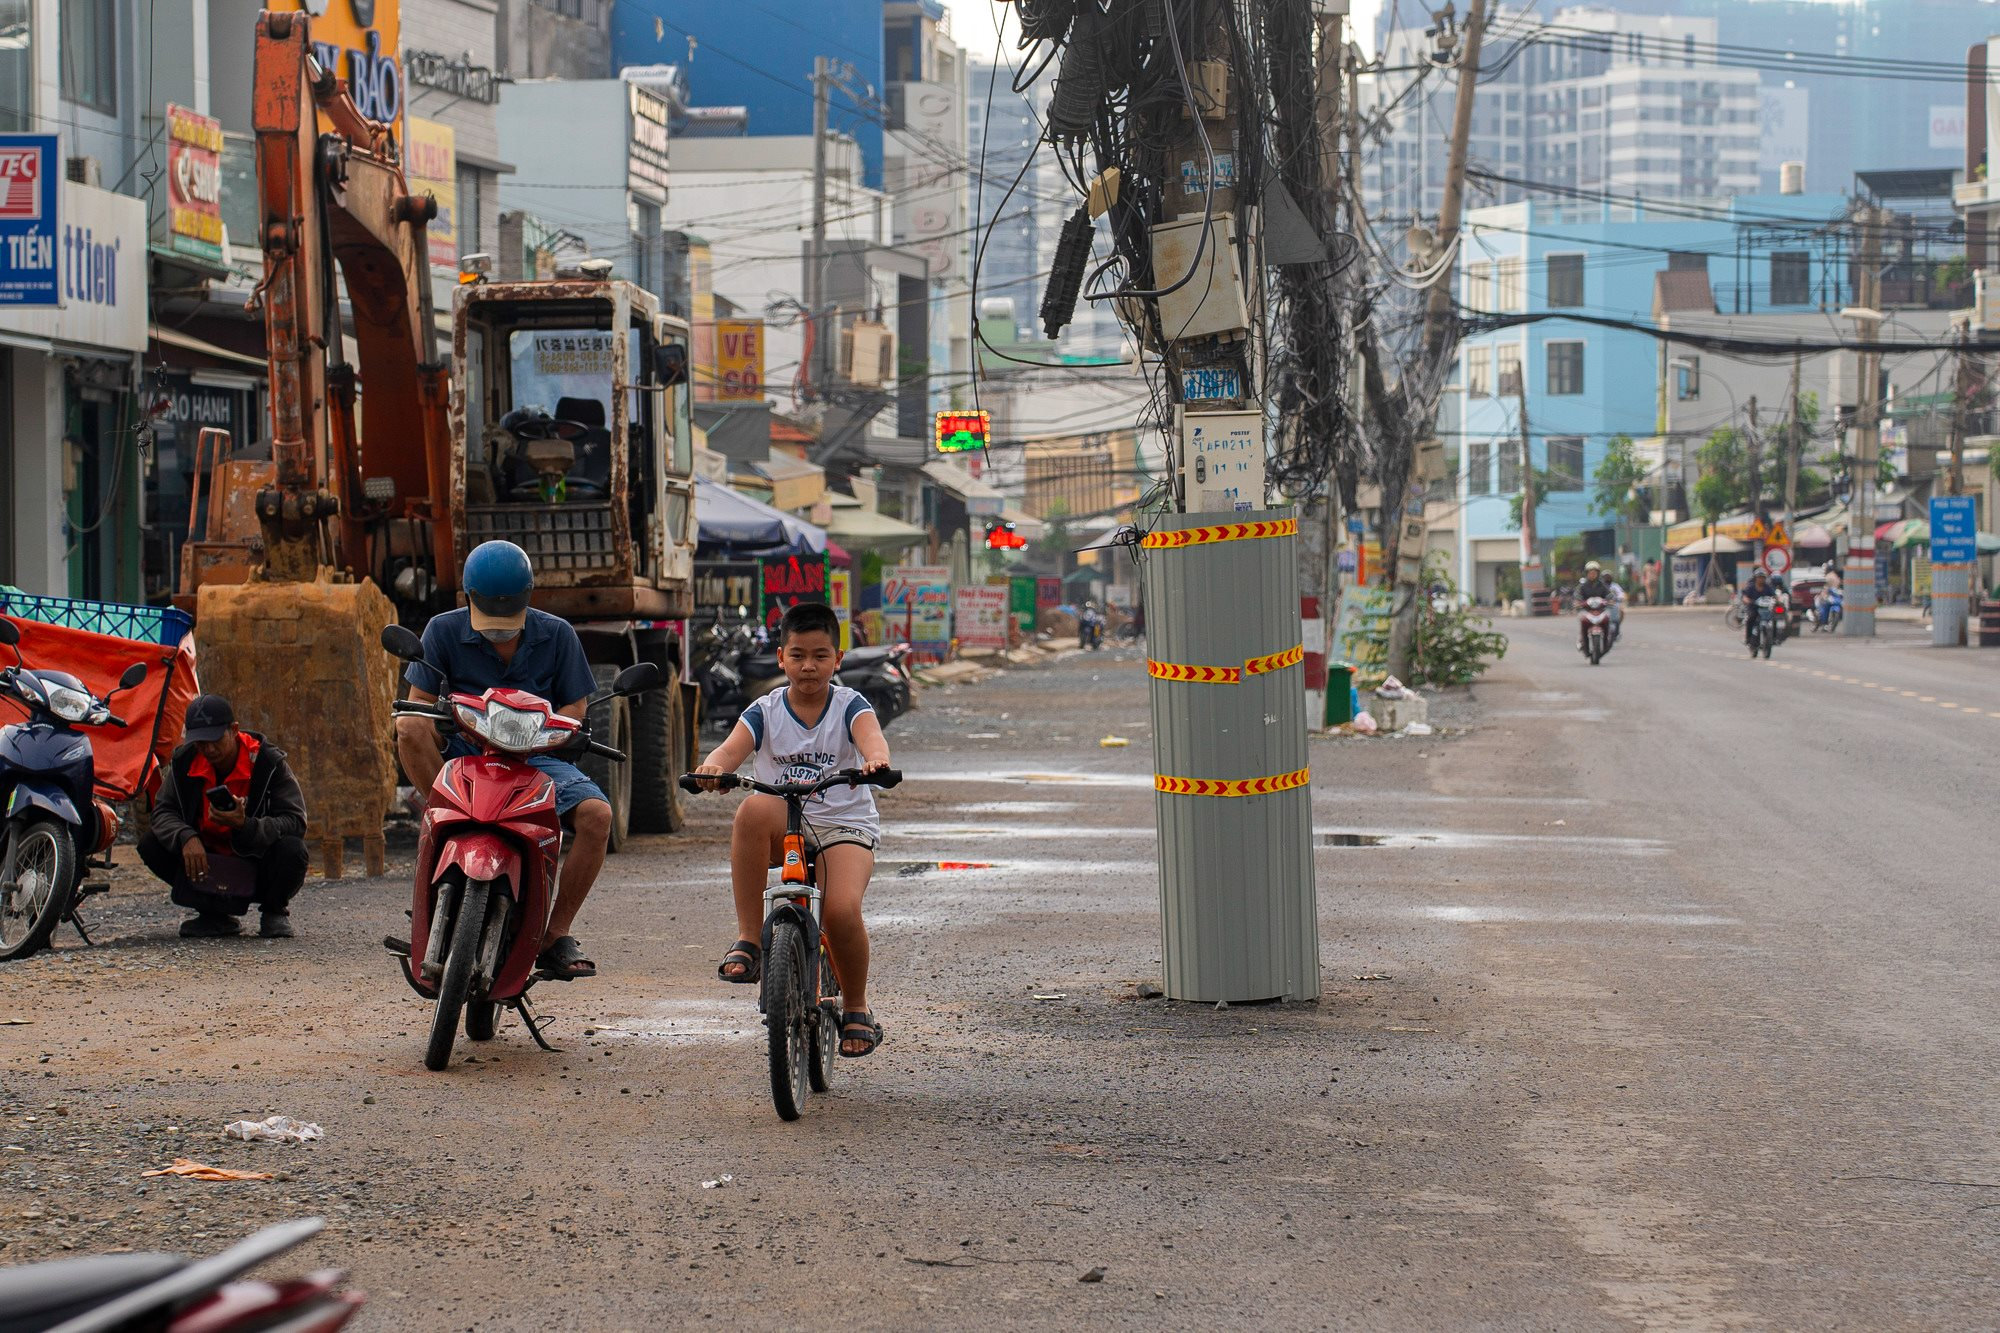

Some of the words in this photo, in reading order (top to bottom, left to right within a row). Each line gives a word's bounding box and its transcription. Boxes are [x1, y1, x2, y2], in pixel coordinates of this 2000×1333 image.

[8, 224, 52, 269] TIẾN
[773, 753, 812, 765] SILENT
[485, 762, 511, 771] HONDA
